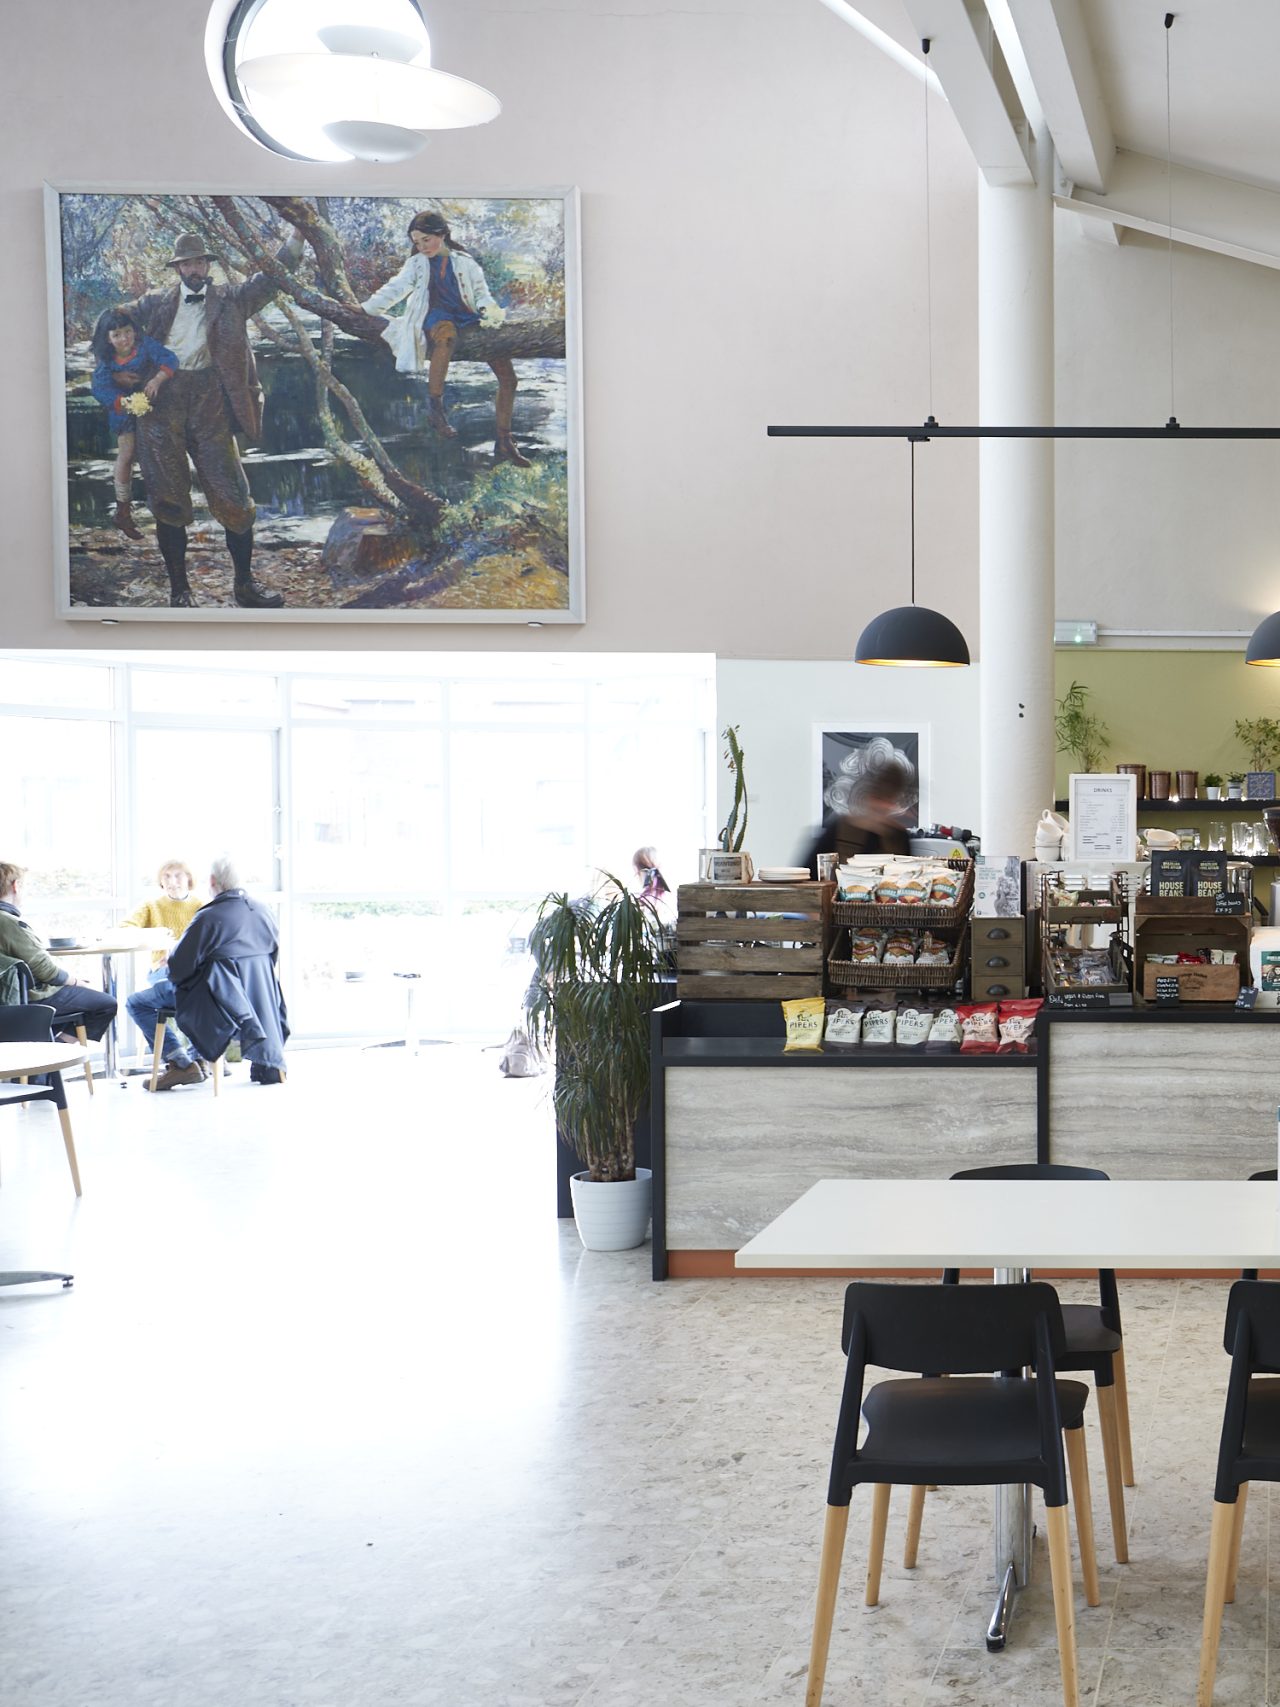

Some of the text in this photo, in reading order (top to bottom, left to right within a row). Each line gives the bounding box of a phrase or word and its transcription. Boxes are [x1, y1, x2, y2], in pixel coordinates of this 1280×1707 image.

[1159, 881, 1184, 890] HOUSE
[1198, 881, 1222, 890] HOUSE
[790, 1020, 818, 1029] PIPERS
[864, 1018, 889, 1027] PIPERS
